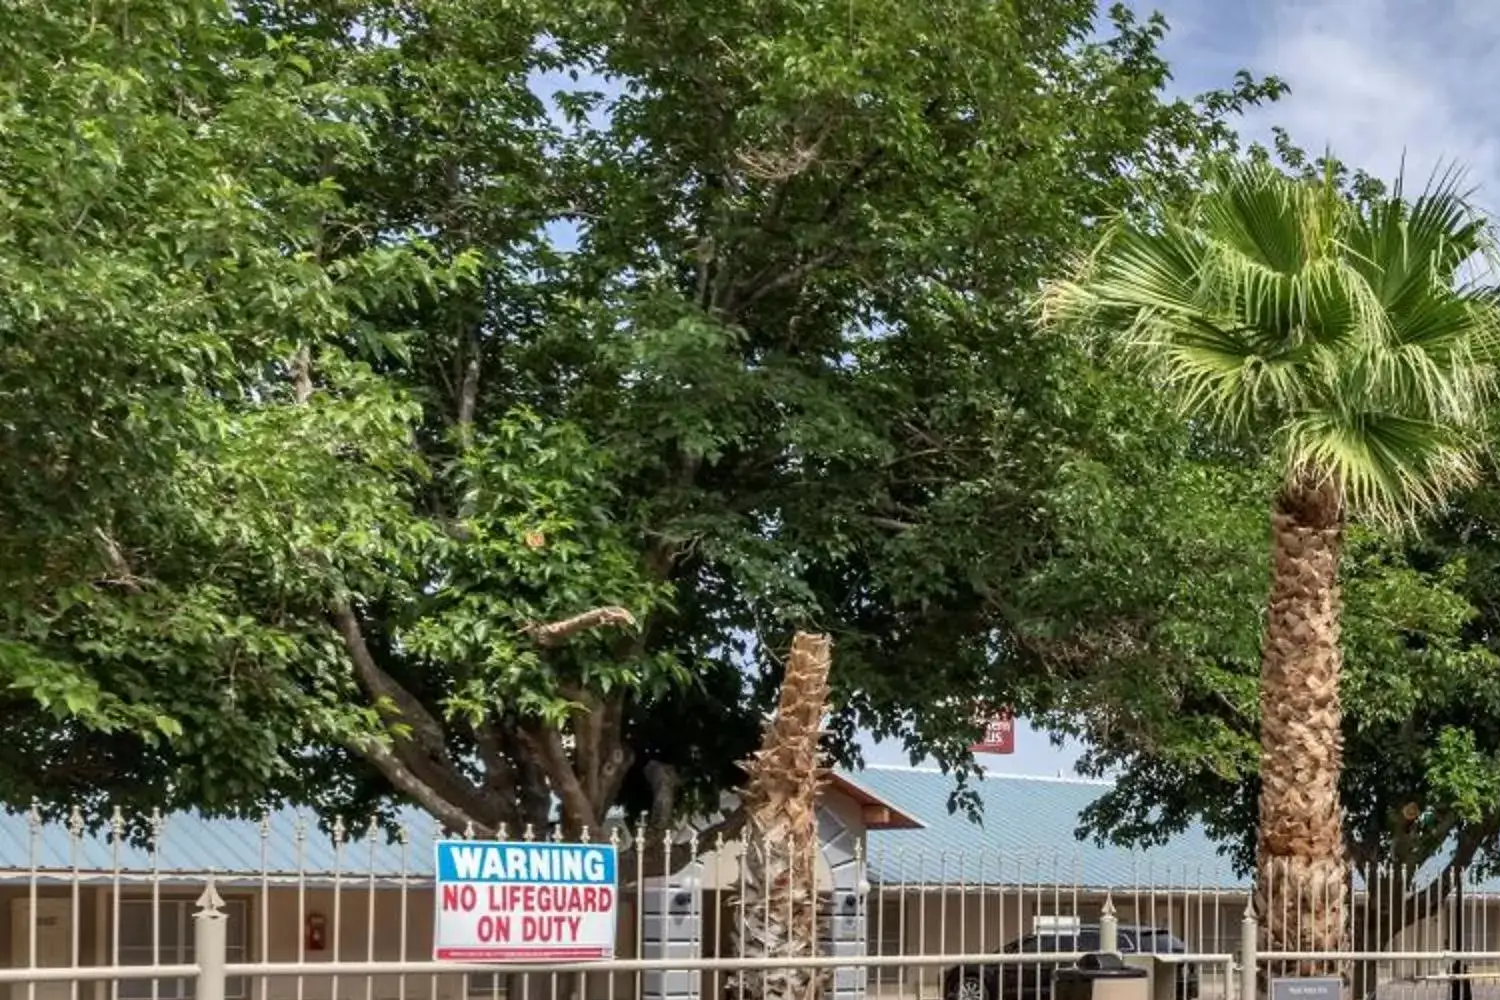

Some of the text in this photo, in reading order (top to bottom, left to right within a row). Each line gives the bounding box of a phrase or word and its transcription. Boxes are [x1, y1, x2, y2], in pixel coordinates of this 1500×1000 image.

[451, 847, 605, 882] WARNING
[443, 884, 612, 913] NO LIFEGUARD
[477, 915, 582, 942] ON DUTY
